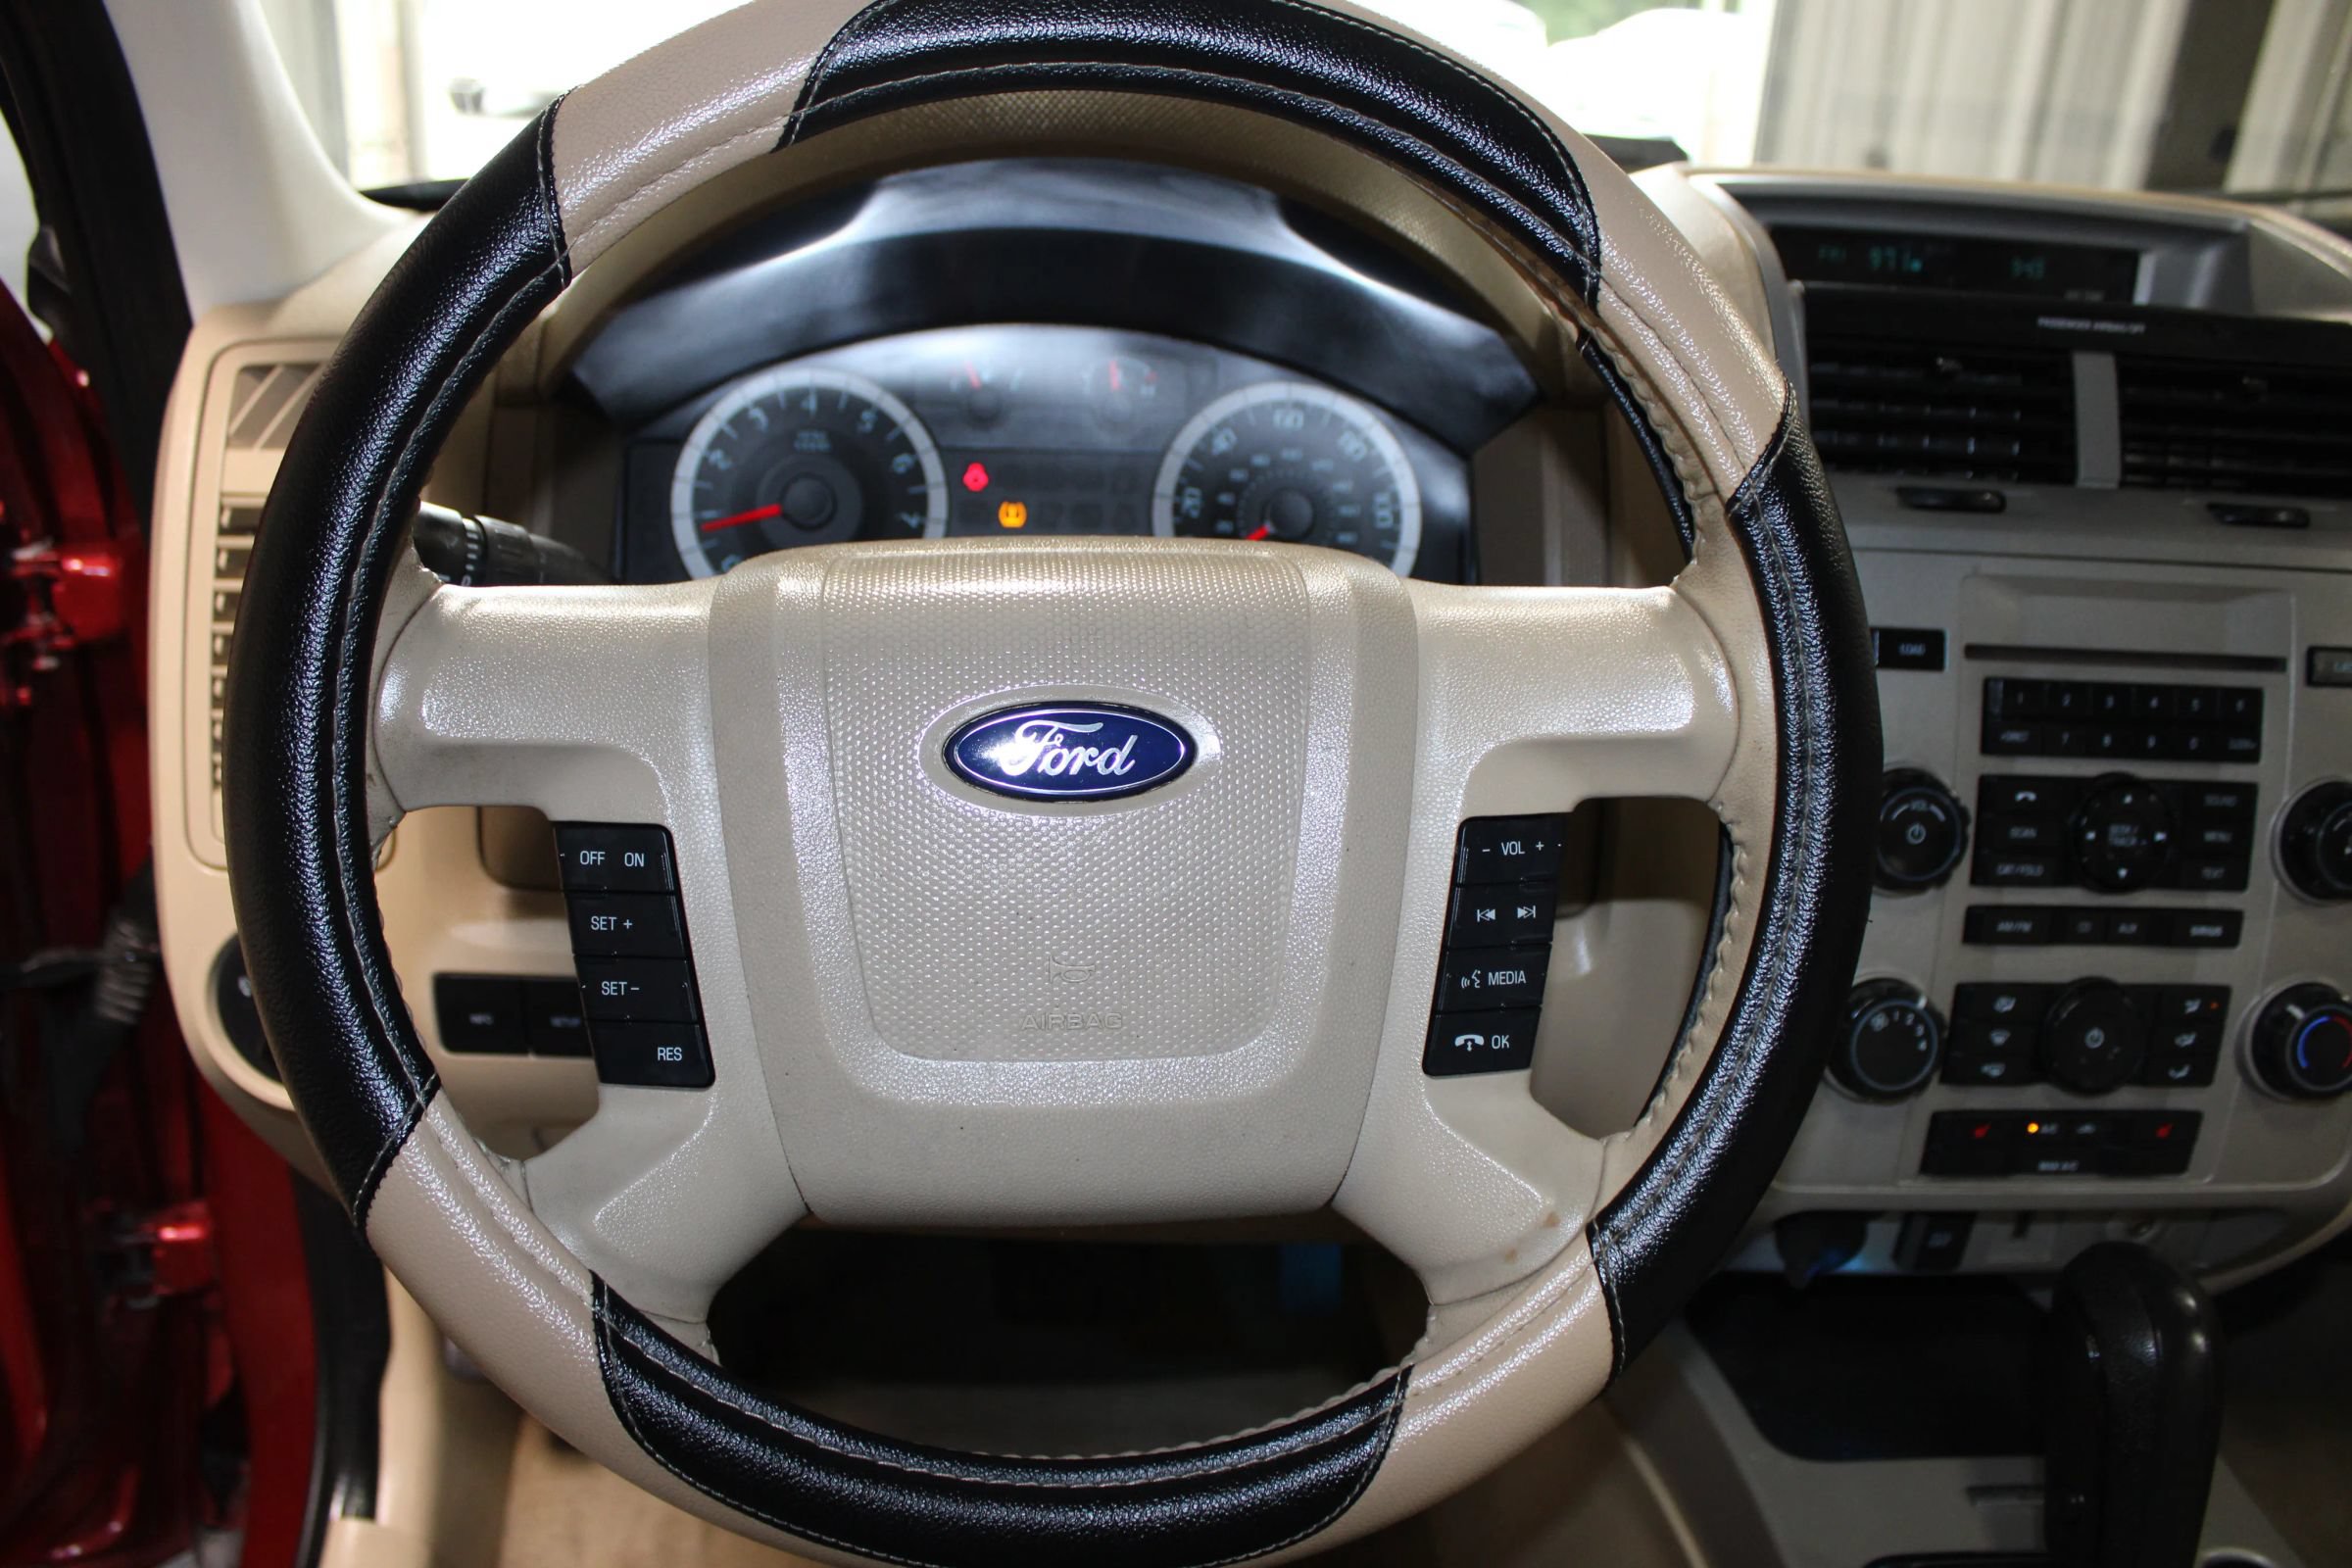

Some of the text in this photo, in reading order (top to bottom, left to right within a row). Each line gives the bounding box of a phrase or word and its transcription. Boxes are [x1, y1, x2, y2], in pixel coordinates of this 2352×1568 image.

[999, 719, 1139, 776] Ford
[1500, 841, 1526, 857] VOL
[579, 851, 646, 867] OFF ON
[590, 915, 617, 931] SET
[1488, 970, 1527, 986] MEDIA
[601, 981, 627, 996] SET
[1021, 1012, 1123, 1030] AIRBAG
[1491, 1034, 1510, 1049] OK
[657, 1047, 683, 1061] RES
